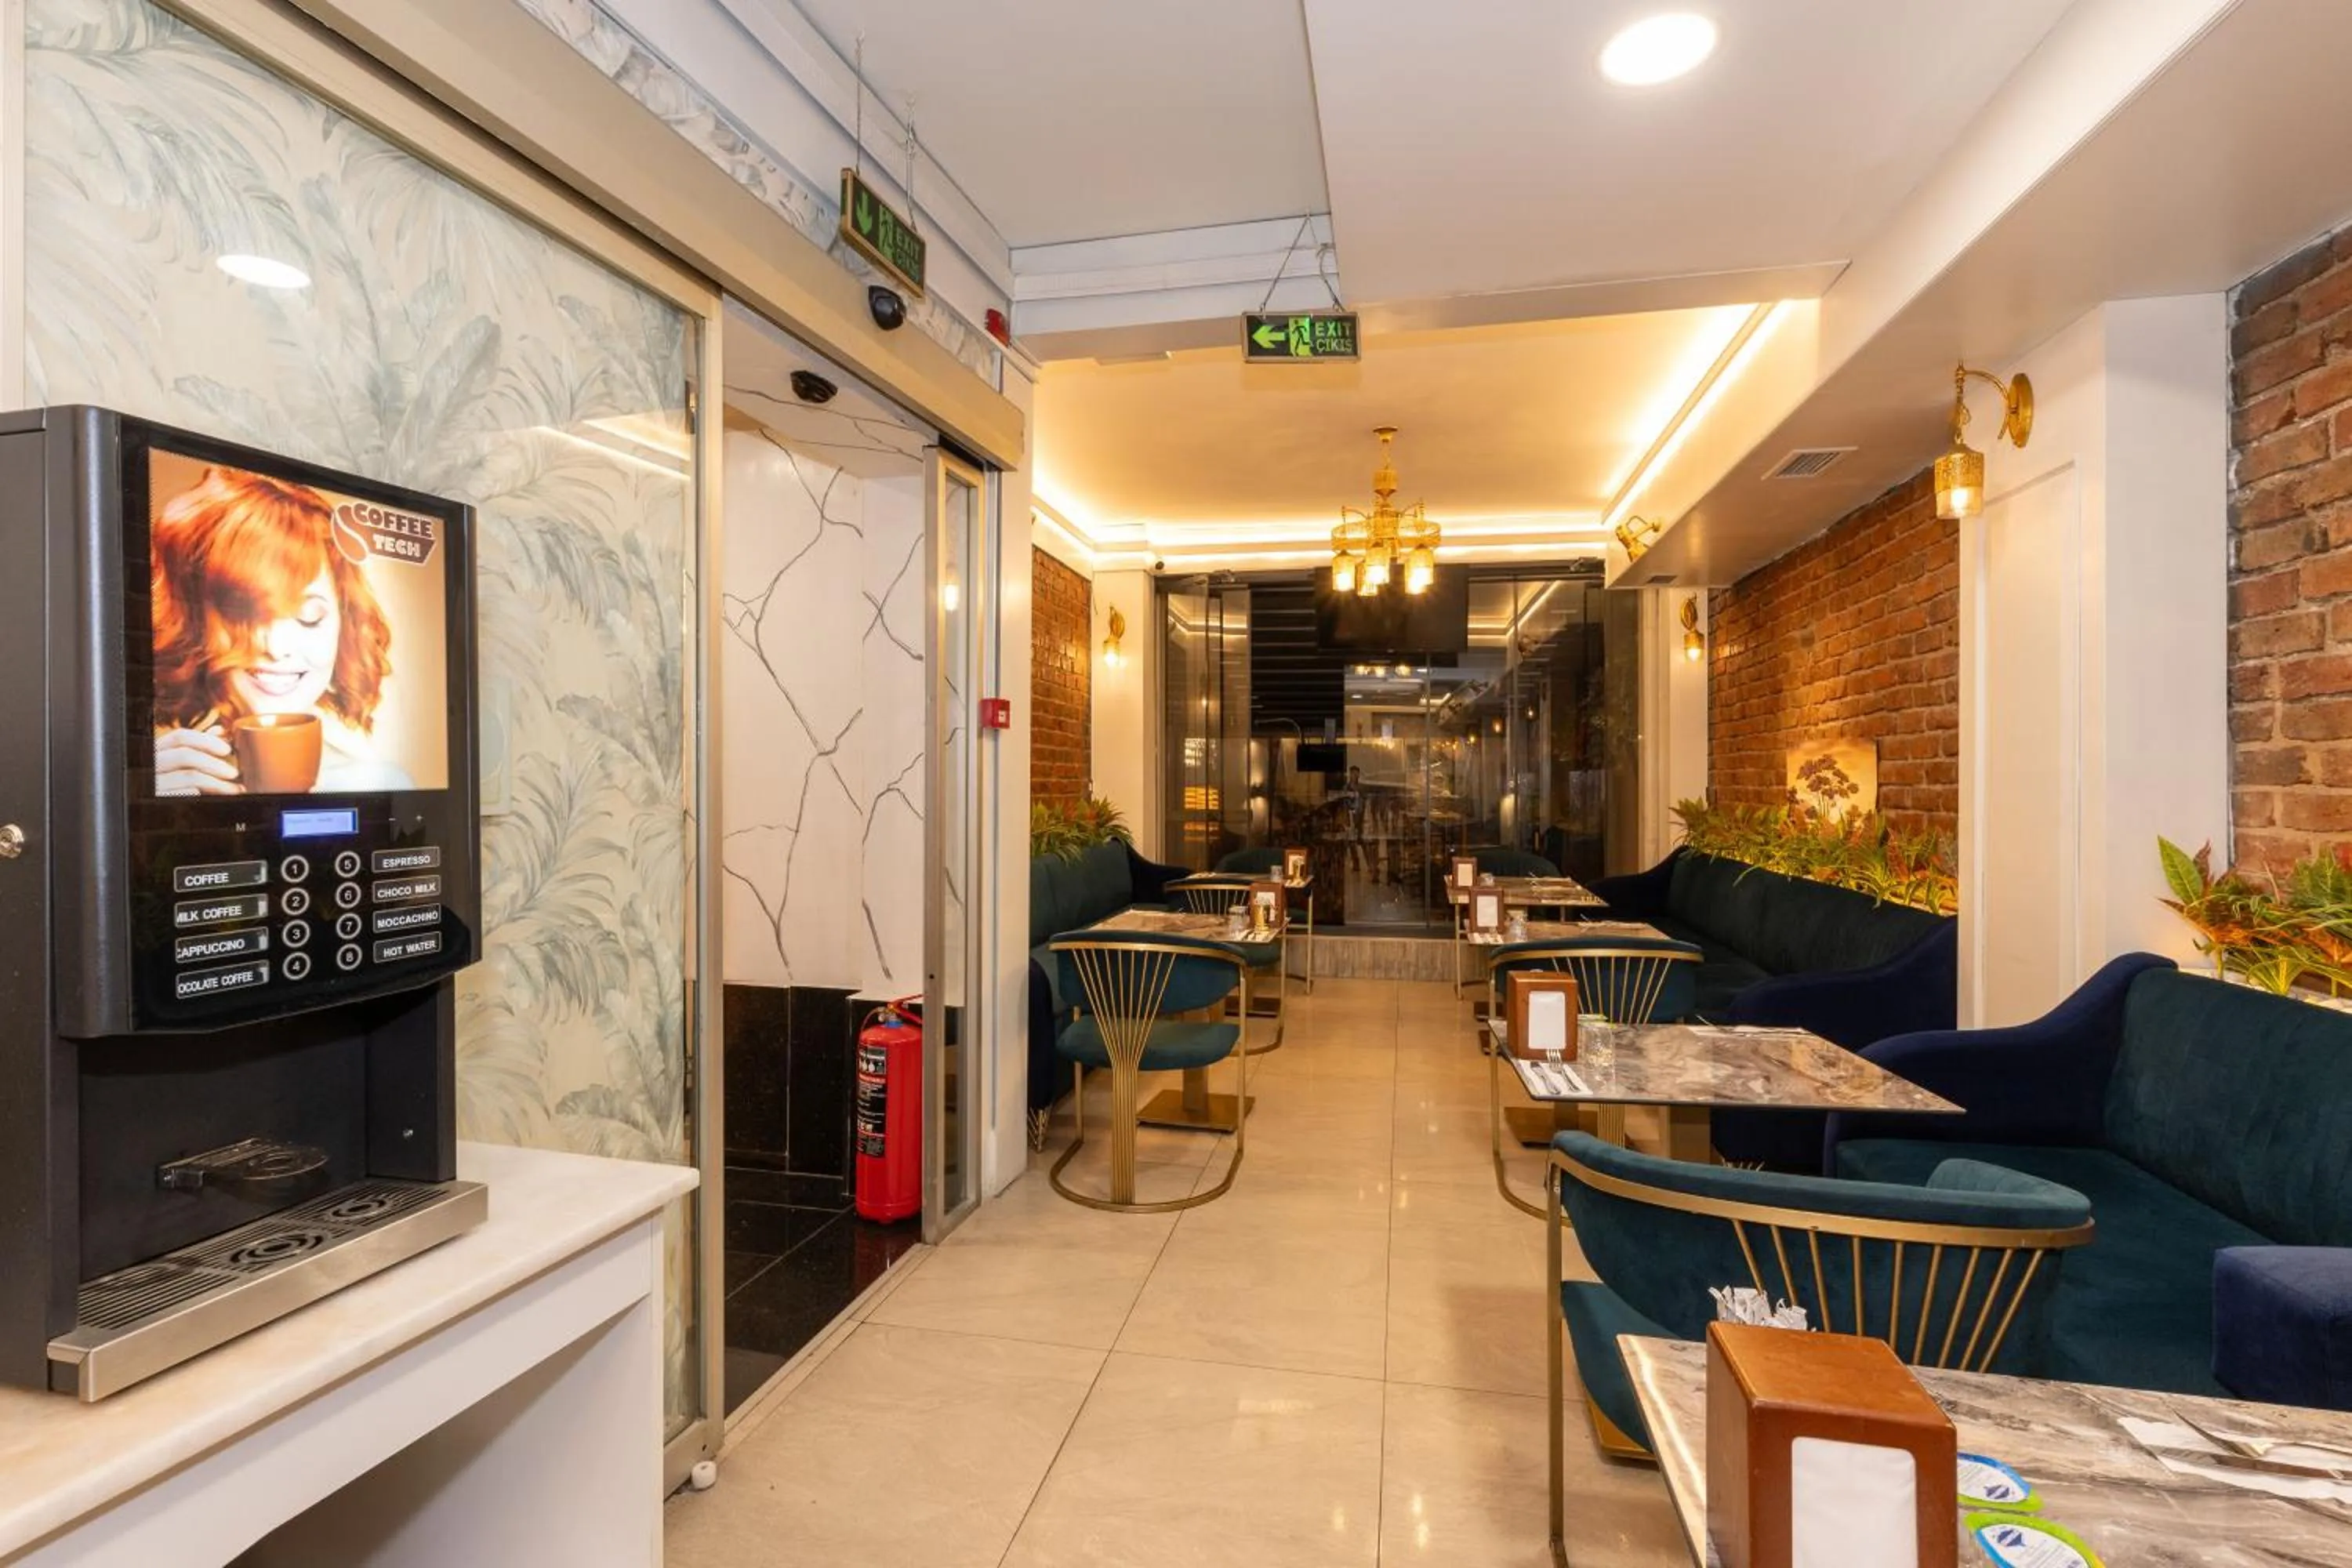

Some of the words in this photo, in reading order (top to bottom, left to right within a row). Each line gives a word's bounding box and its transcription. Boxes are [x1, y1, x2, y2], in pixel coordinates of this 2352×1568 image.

[1315, 321, 1352, 337] EXIT
[354, 503, 434, 538] COFFEE
[372, 534, 420, 557] TECH
[236, 822, 245, 832] M
[344, 859, 352, 870] 5
[383, 855, 430, 868] ESPRESSO
[292, 864, 298, 874] 1
[184, 873, 230, 887] COFFEE
[344, 891, 352, 901] 6
[377, 886, 412, 898] CHOCO
[415, 883, 437, 893] MILK
[292, 896, 300, 907] 2
[202, 905, 242, 920] COFFEE
[346, 921, 353, 932] 7
[292, 928, 300, 940] 3
[383, 946, 402, 958] HOT
[405, 940, 437, 954] WATER
[346, 951, 354, 963] 8
[292, 960, 300, 971] 4
[220, 971, 254, 986] COFFEE
